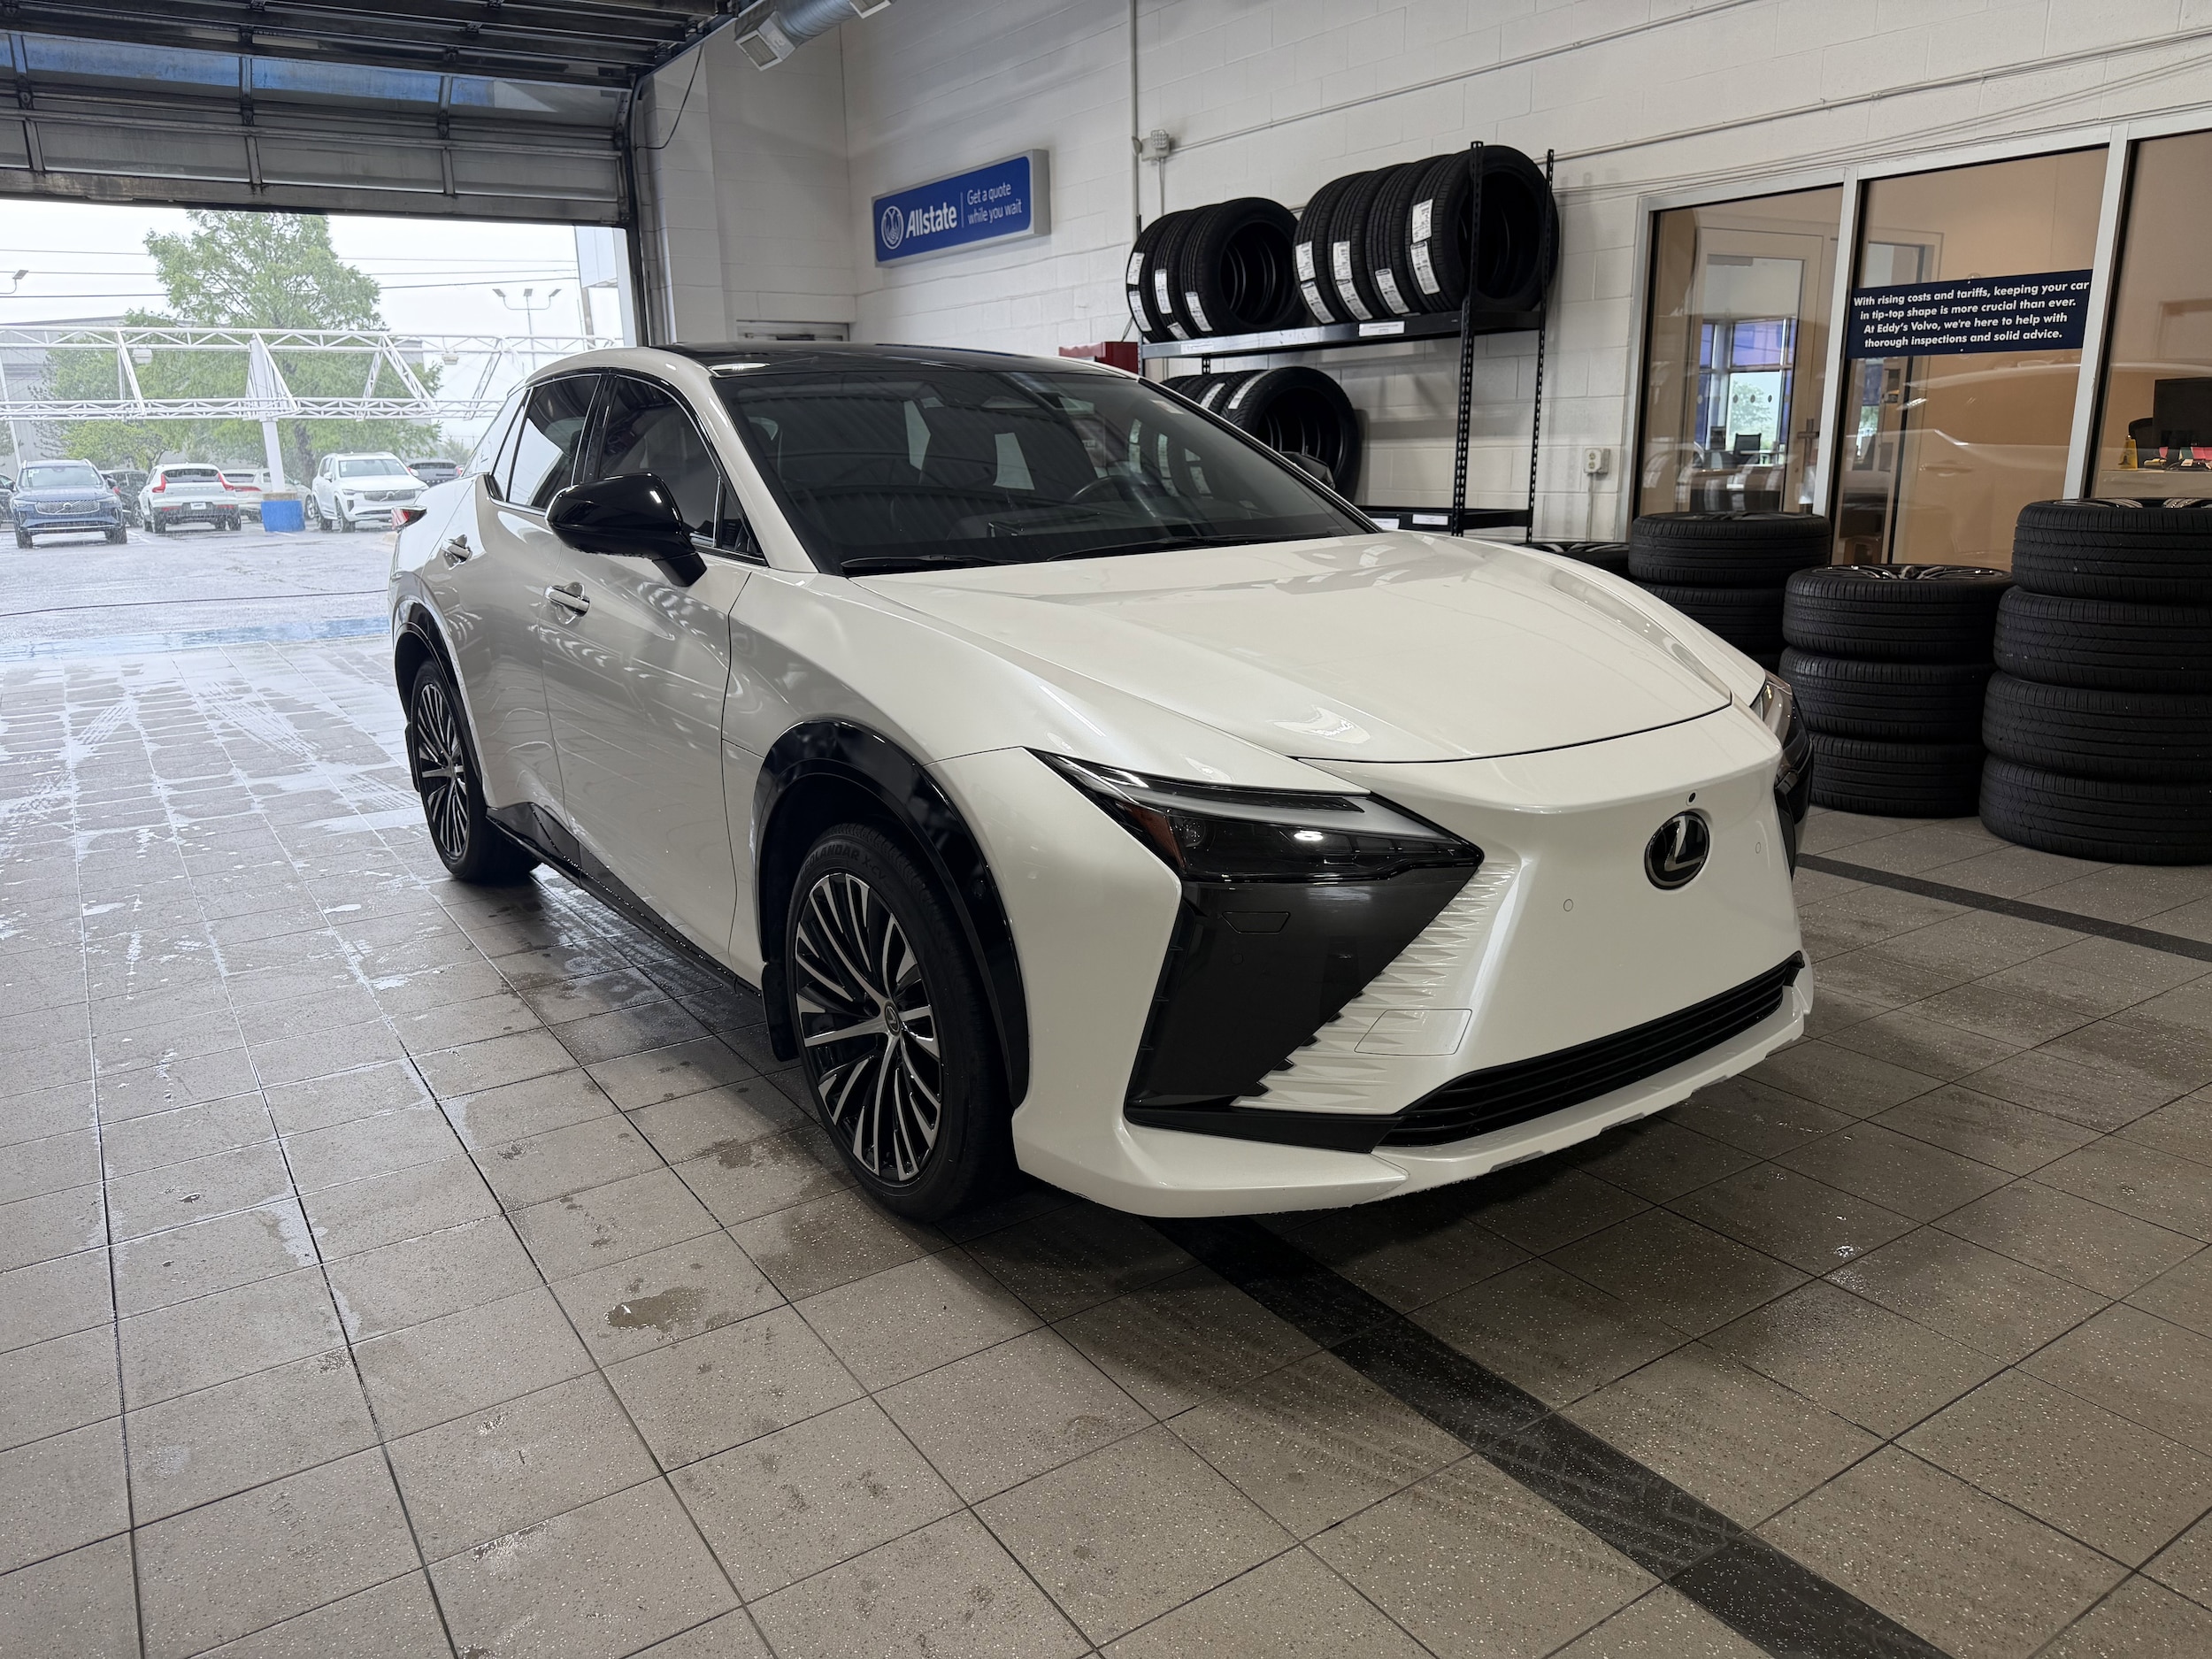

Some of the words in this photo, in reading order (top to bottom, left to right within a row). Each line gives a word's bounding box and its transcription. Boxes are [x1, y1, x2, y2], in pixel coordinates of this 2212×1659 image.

[967, 189, 981, 205] Get
[982, 190, 987, 202] a
[988, 182, 1011, 203] quote
[905, 202, 957, 239] Allstate
[968, 207, 988, 225] while
[988, 206, 1004, 224] you
[1004, 198, 1022, 216] wait
[1854, 296, 1875, 306] With
[1878, 295, 1905, 305] rising
[1908, 292, 1932, 303] costs
[1934, 289, 1955, 301] and
[1957, 287, 1991, 299] tariffs,
[1993, 284, 2039, 297] keeping
[2041, 283, 2068, 295] your
[2070, 281, 2089, 291] car
[1860, 311, 1870, 320] in
[1871, 310, 1905, 320] tip-top
[1907, 306, 1938, 318] shape
[1940, 305, 1948, 315] is
[1951, 303, 1978, 314] more
[1981, 300, 2016, 312] crucial
[2019, 299, 2046, 310] than
[2048, 298, 2077, 308] ever.
[1863, 325, 1875, 334] At
[1877, 322, 1909, 334] Eddy's
[1911, 320, 1941, 331] Volvo,
[1944, 319, 1971, 329] we're
[1974, 318, 1999, 327] here
[2001, 317, 2013, 326] to
[2015, 314, 2040, 326] help
[2043, 312, 2068, 324] with
[1864, 337, 1909, 349] thorough
[1911, 334, 1967, 347] inspections
[1970, 332, 1992, 342] and
[1993, 330, 2020, 342] solid
[2023, 328, 2062, 340] advice.
[802, 845, 860, 877] GEOLANDAR
[863, 854, 887, 880] X-CV
